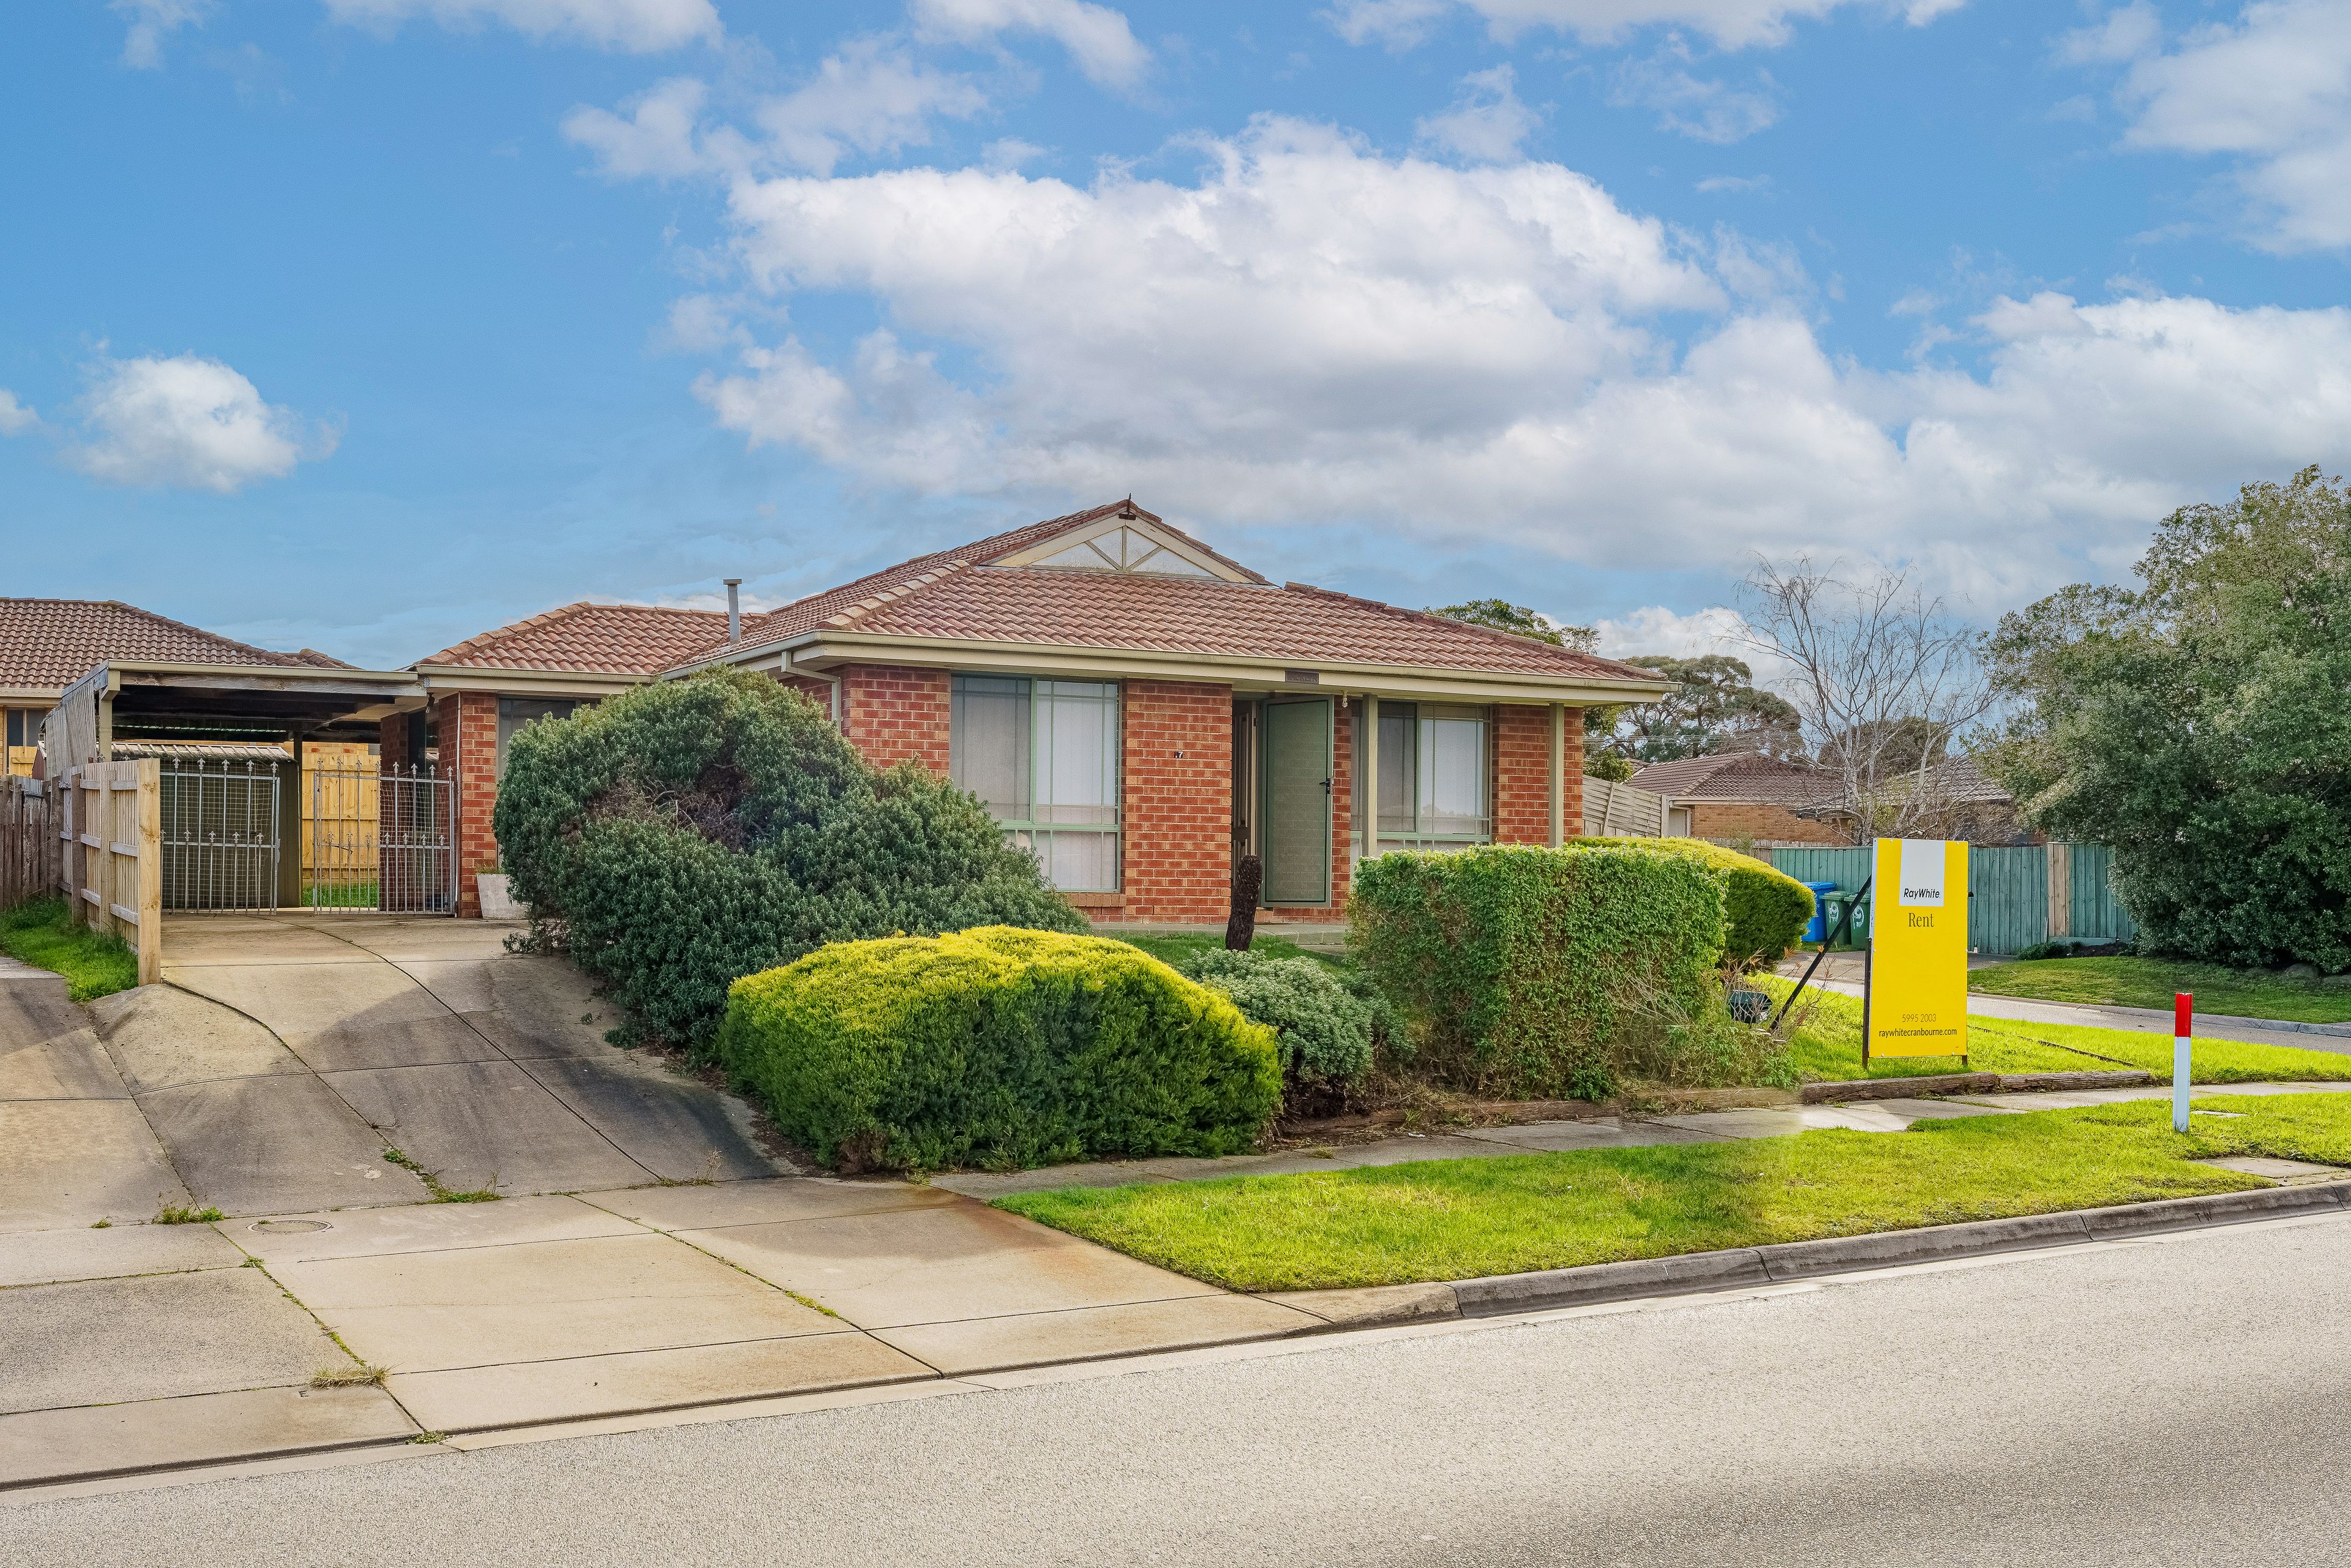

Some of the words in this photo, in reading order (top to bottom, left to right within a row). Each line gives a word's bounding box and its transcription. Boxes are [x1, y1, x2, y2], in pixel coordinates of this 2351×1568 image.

[1903, 888, 1940, 899] RayWhite
[1908, 912, 1934, 927] Rent
[1902, 1014, 1919, 1022] 5995
[1920, 1013, 1937, 1022] 2003
[1879, 1027, 1957, 1038] raywhitecranbourne.com
